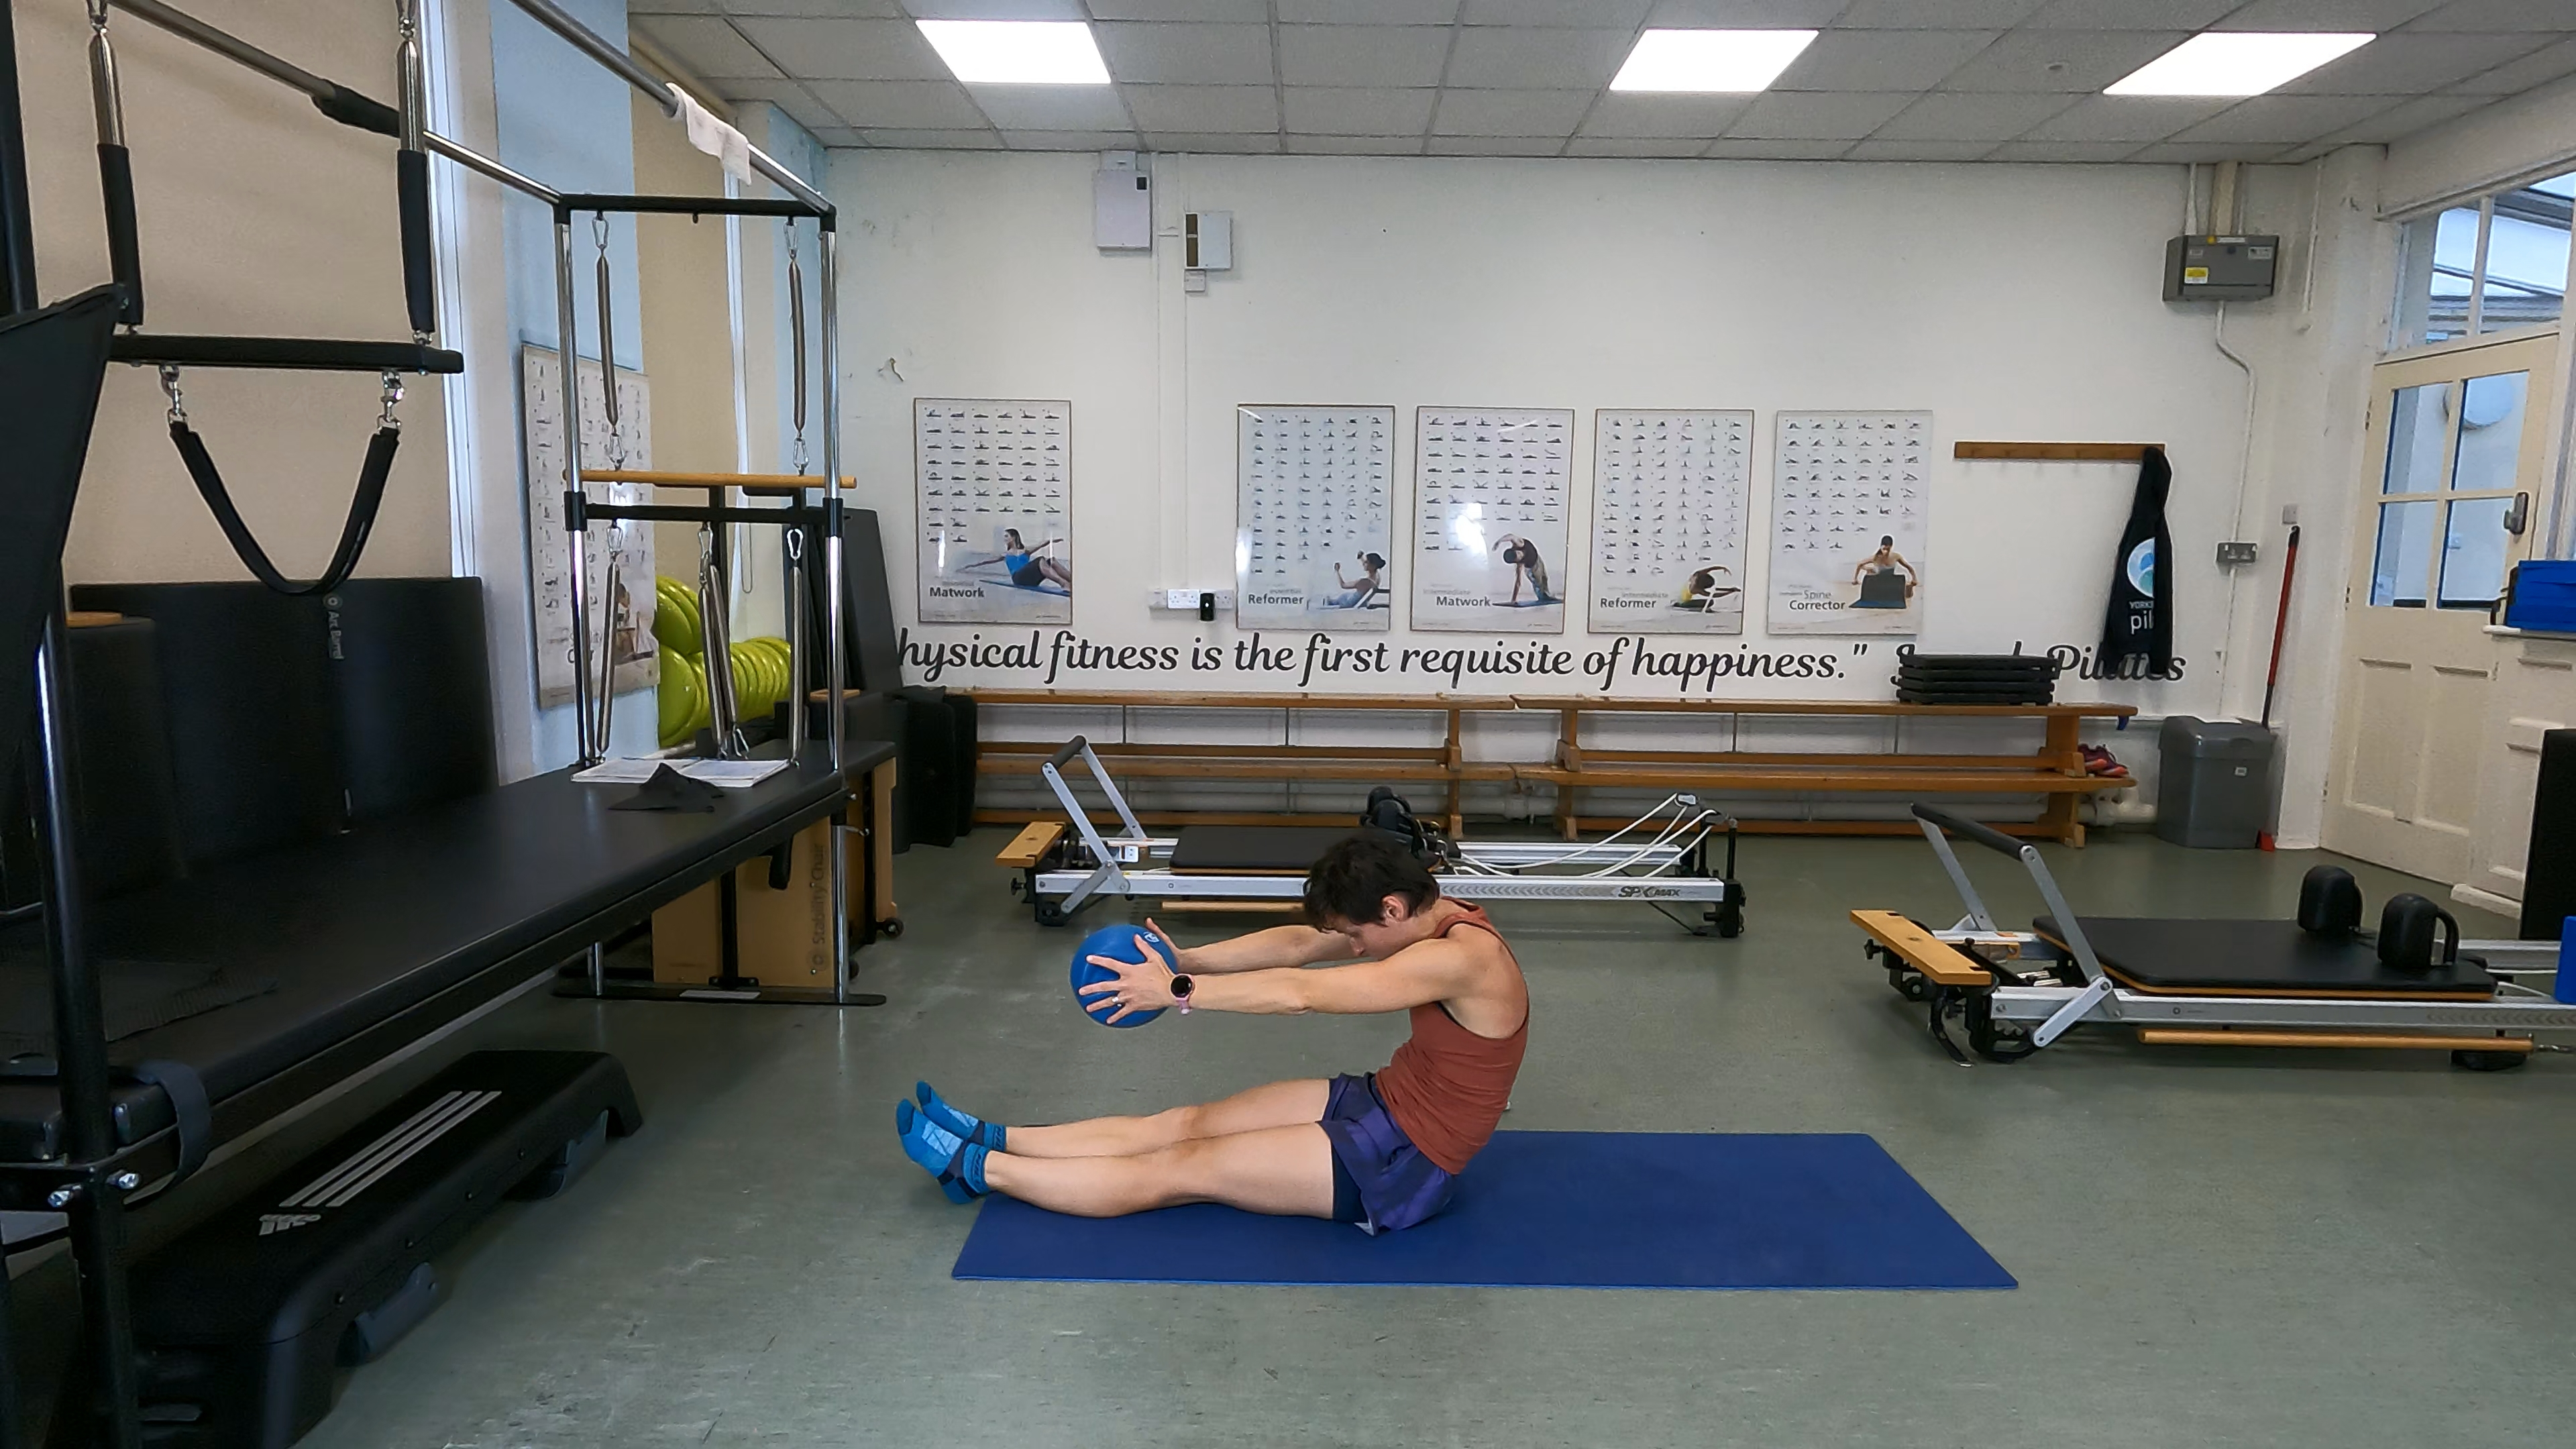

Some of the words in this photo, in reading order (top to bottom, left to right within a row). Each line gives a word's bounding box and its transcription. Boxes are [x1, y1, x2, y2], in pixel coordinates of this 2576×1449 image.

[930, 586, 985, 598] Matwork
[1248, 593, 1304, 604] Reformer
[1436, 596, 1491, 606] Matwork
[1600, 597, 1656, 608] Reformer
[1789, 600, 1845, 610] Corrector
[1044, 631, 1179, 684] fitness
[1192, 637, 1223, 671] is
[1234, 633, 1297, 671] the
[1298, 633, 1390, 688] first
[1400, 641, 1574, 689] requisite
[1583, 637, 1630, 691] of
[1631, 637, 1868, 692] happiness."
